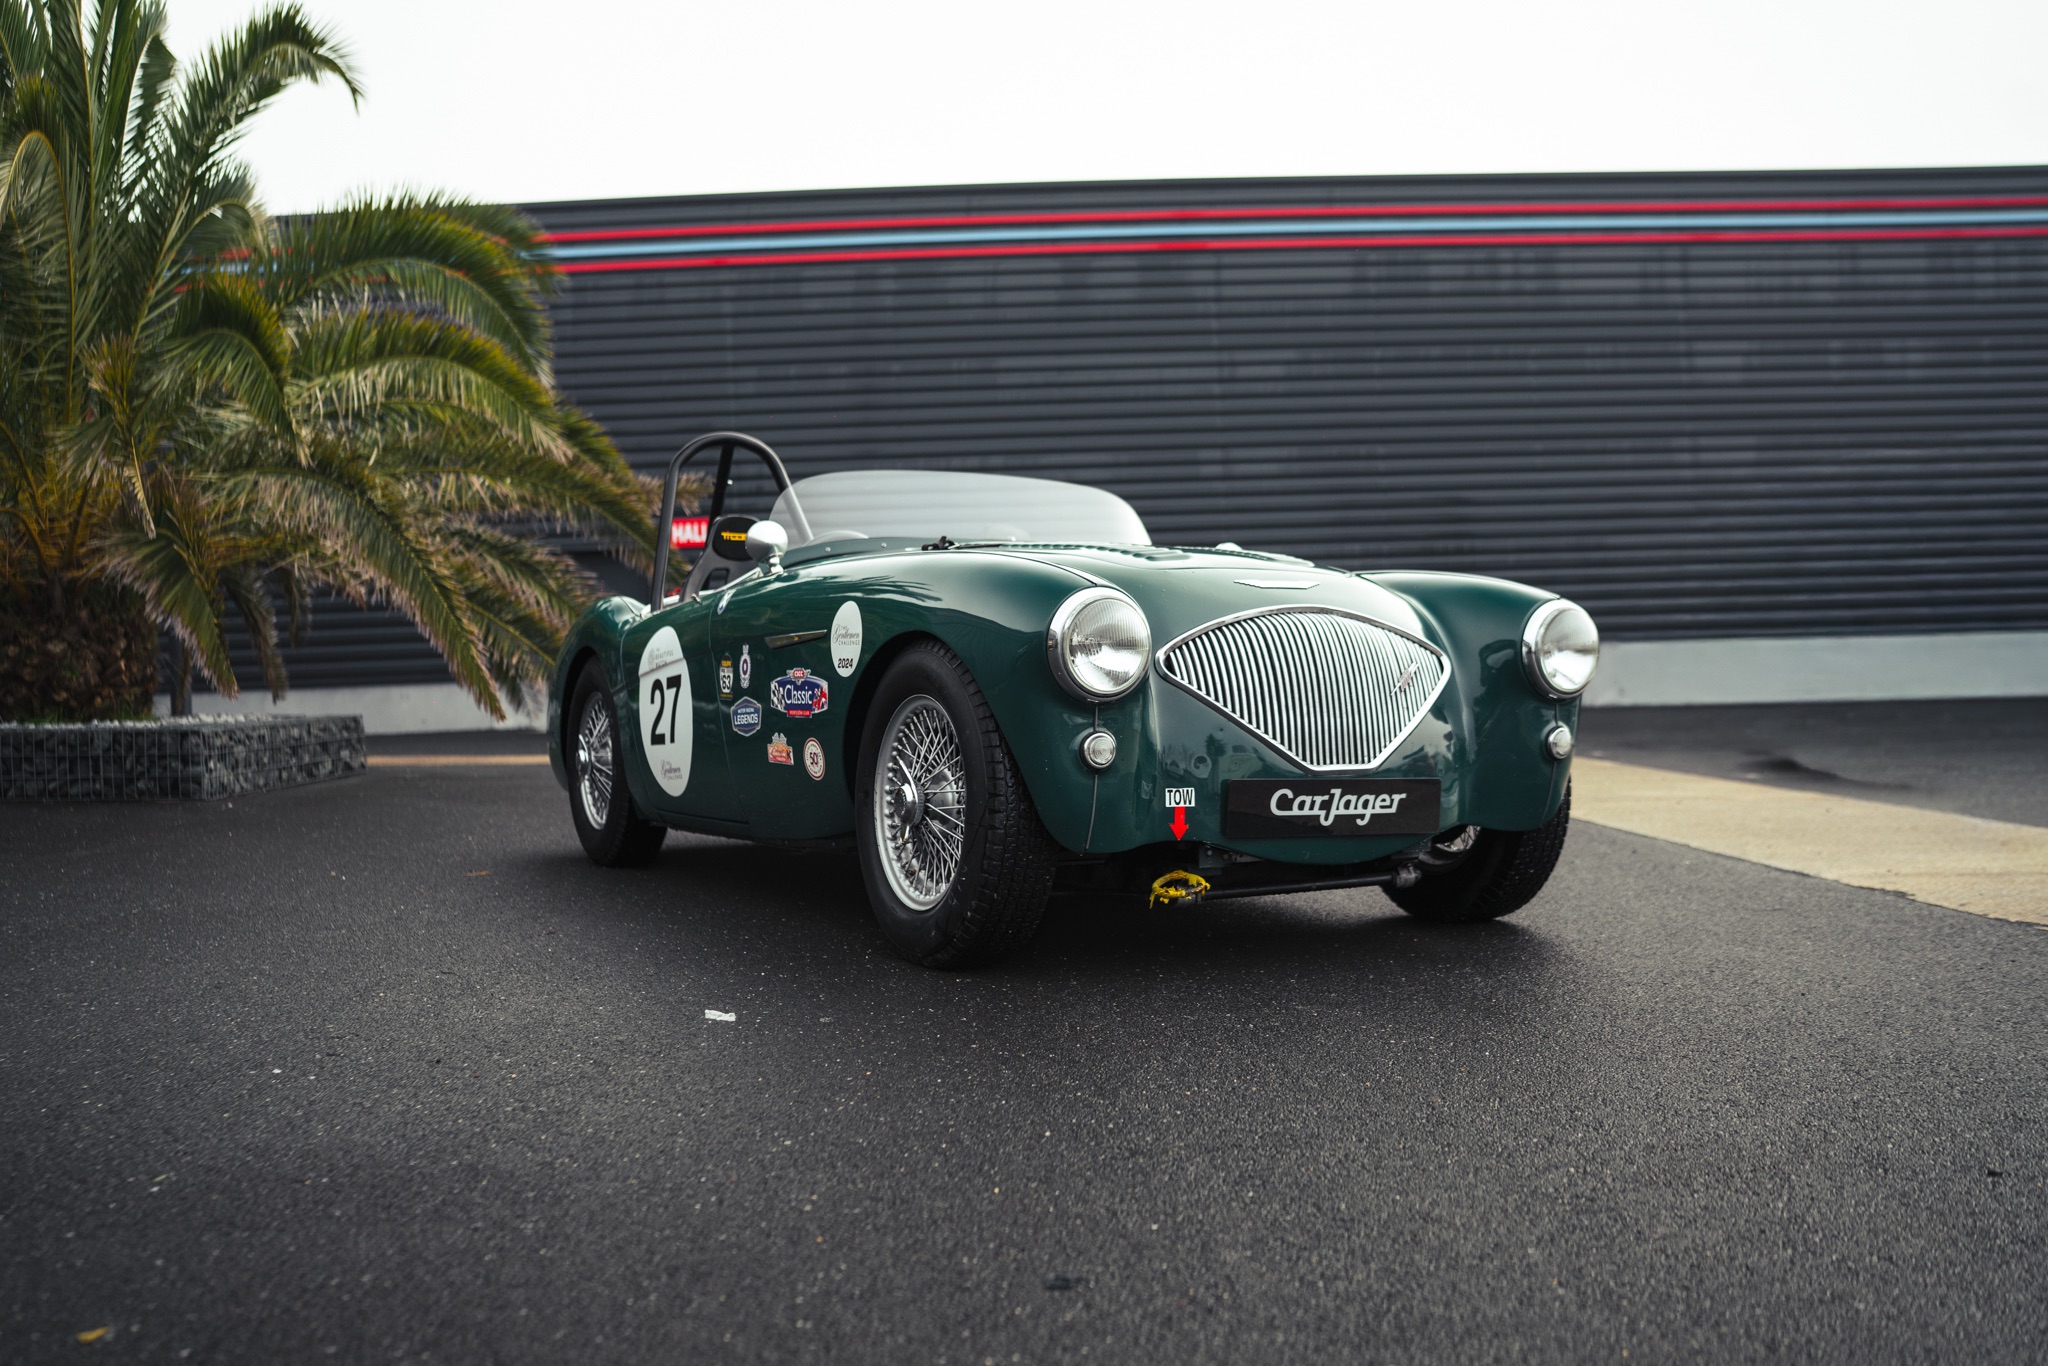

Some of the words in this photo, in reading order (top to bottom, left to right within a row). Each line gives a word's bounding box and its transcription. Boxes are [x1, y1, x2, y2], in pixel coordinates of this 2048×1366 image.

[837, 658, 853, 669] 2024
[784, 685, 812, 704] Classic
[650, 674, 682, 746] 27
[734, 714, 759, 725] LEGENDS
[1167, 789, 1194, 806] TOW
[1270, 788, 1407, 827] CarJager
